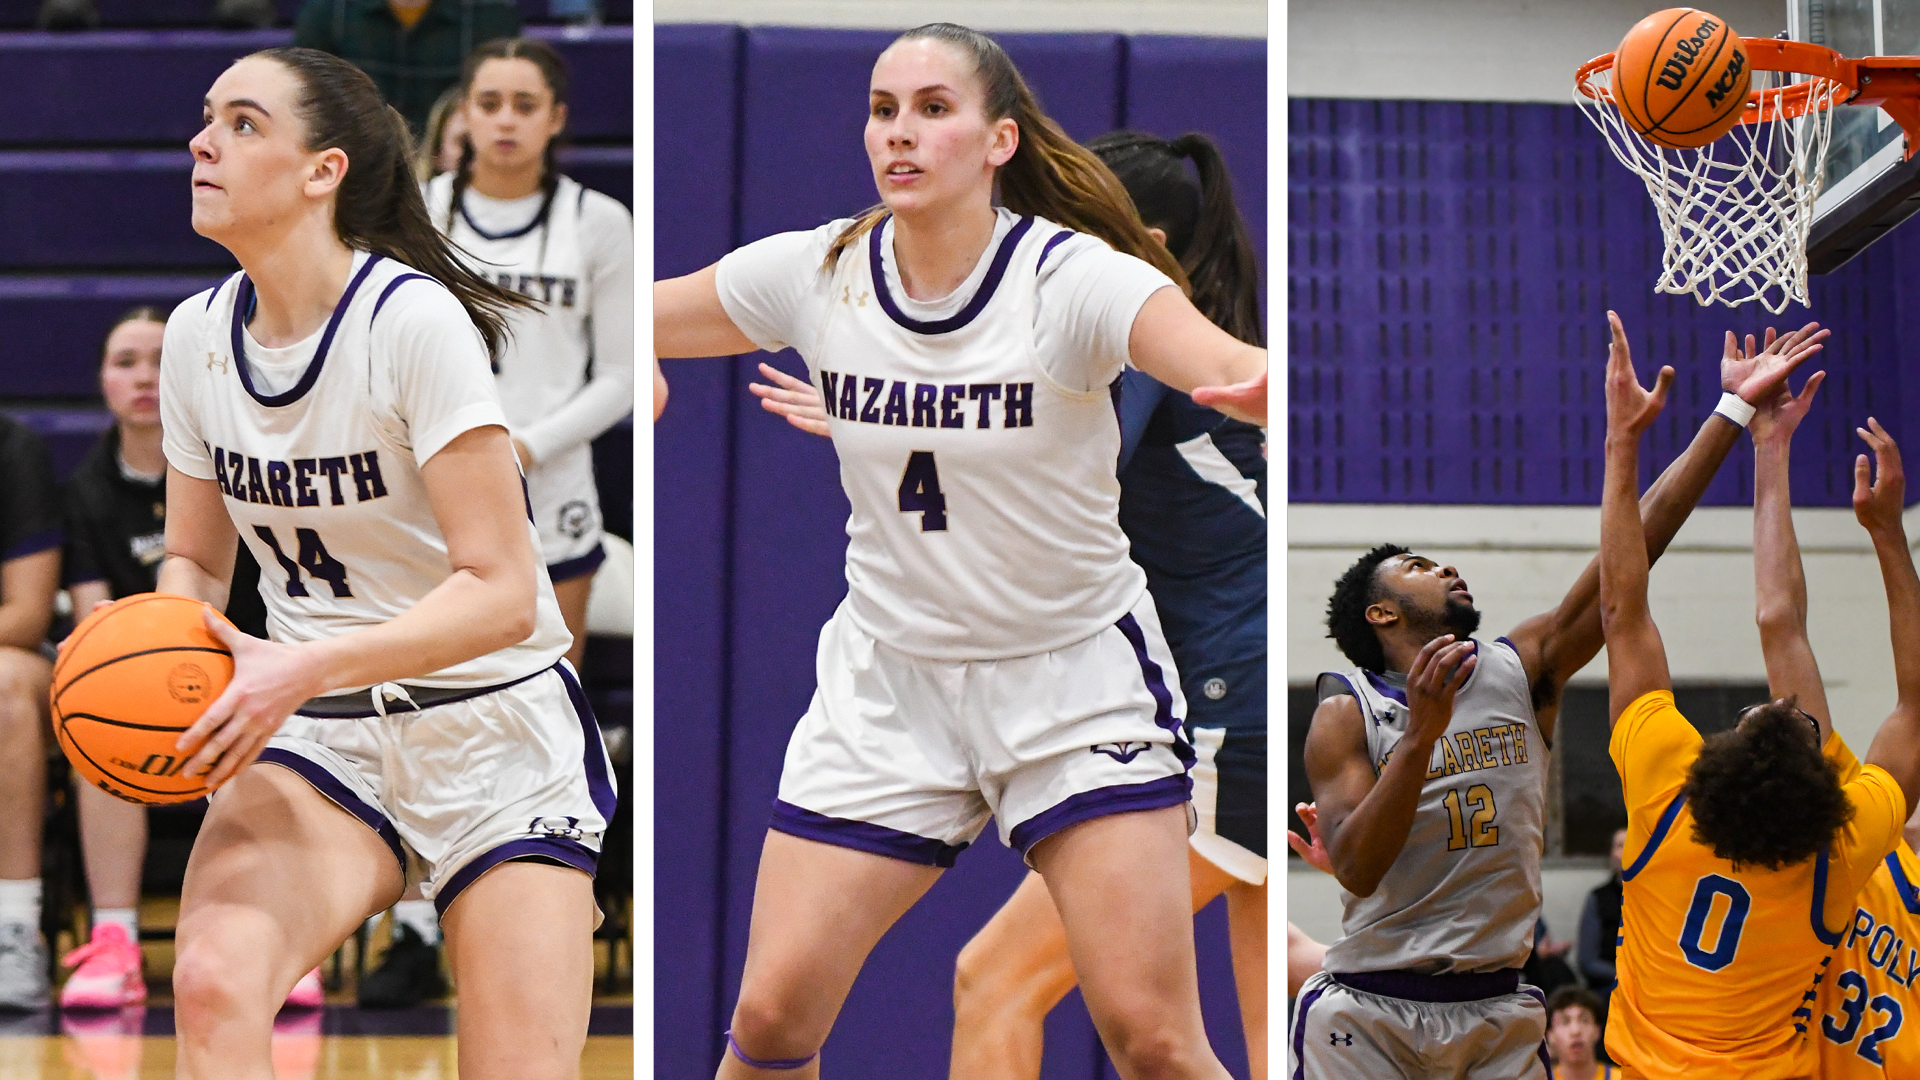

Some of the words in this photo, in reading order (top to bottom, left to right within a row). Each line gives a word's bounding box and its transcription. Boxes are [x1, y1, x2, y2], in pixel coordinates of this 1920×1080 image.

[1656, 19, 1719, 91] Wilson
[1705, 49, 1745, 109] NCAA
[820, 370, 1034, 429] NAZARETH
[203, 440, 389, 507] AZARETH
[898, 450, 948, 533] 4
[251, 523, 355, 598] 14
[1442, 783, 1499, 851] 12
[1678, 872, 1752, 973] 0
[1846, 906, 1920, 991] POLY
[1820, 968, 1904, 1069] 32
